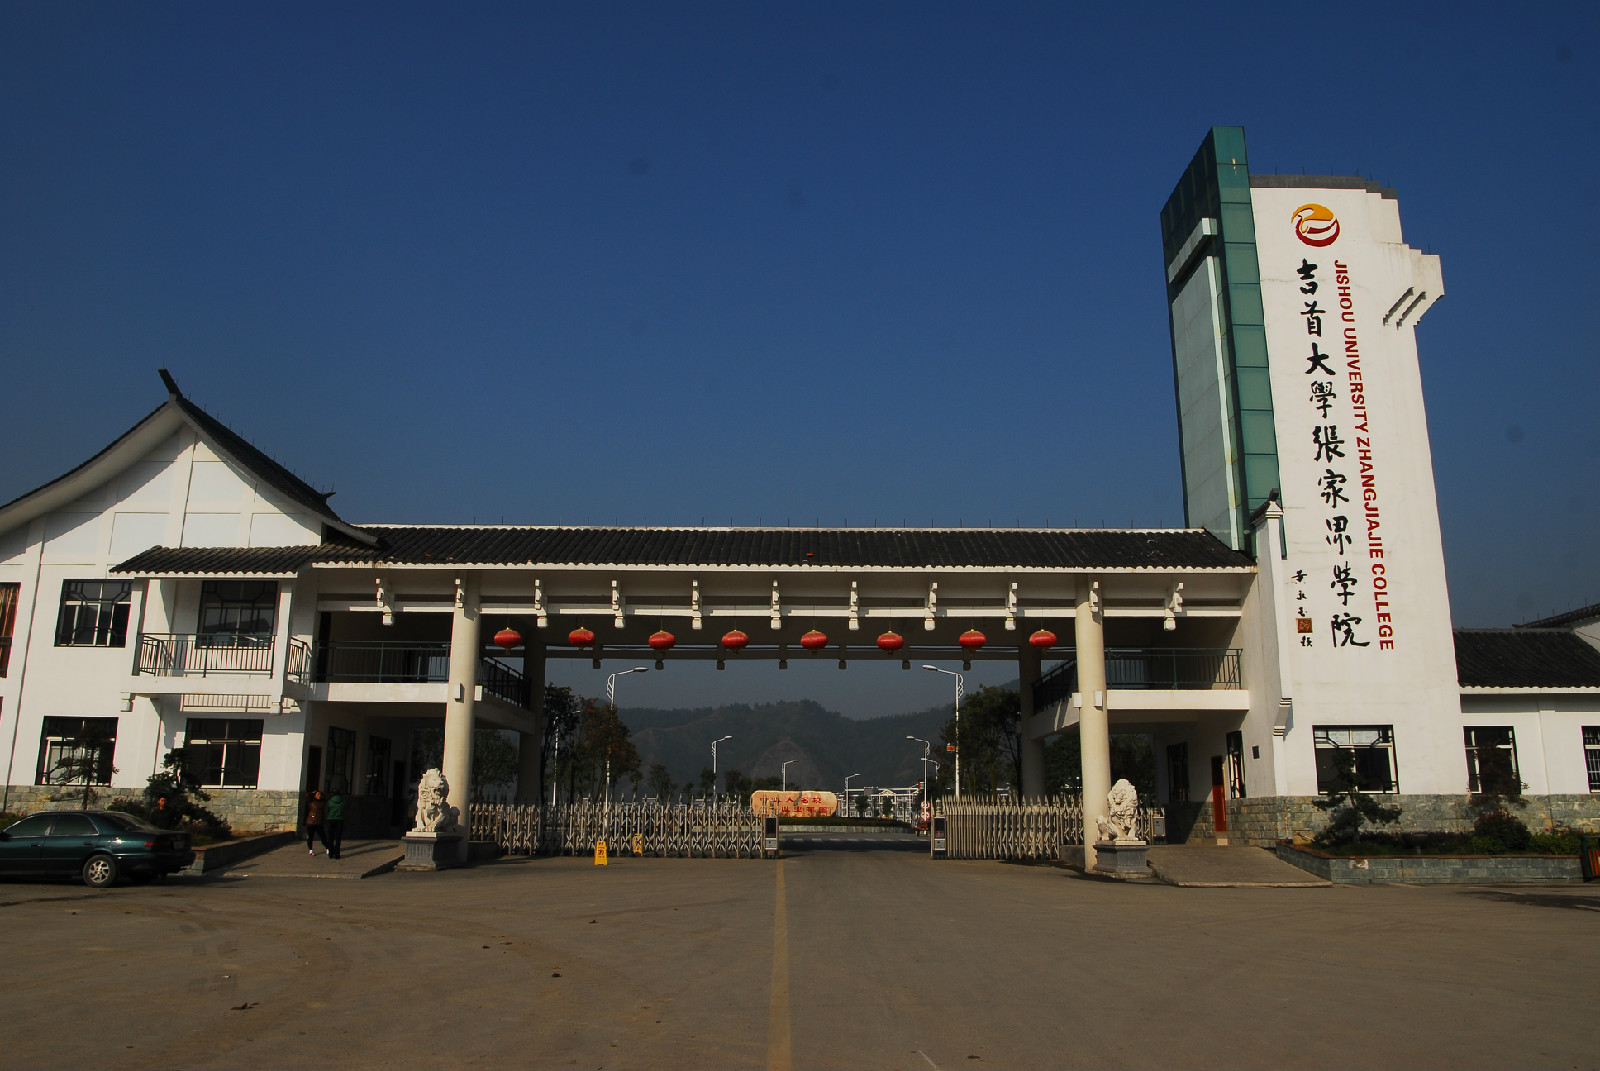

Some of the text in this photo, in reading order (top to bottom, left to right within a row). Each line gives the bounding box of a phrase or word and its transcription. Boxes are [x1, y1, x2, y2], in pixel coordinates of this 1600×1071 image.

[1334, 259, 1394, 651] JISHOU UNIVERSITY ZHANGJIAJIE COLLEGE
